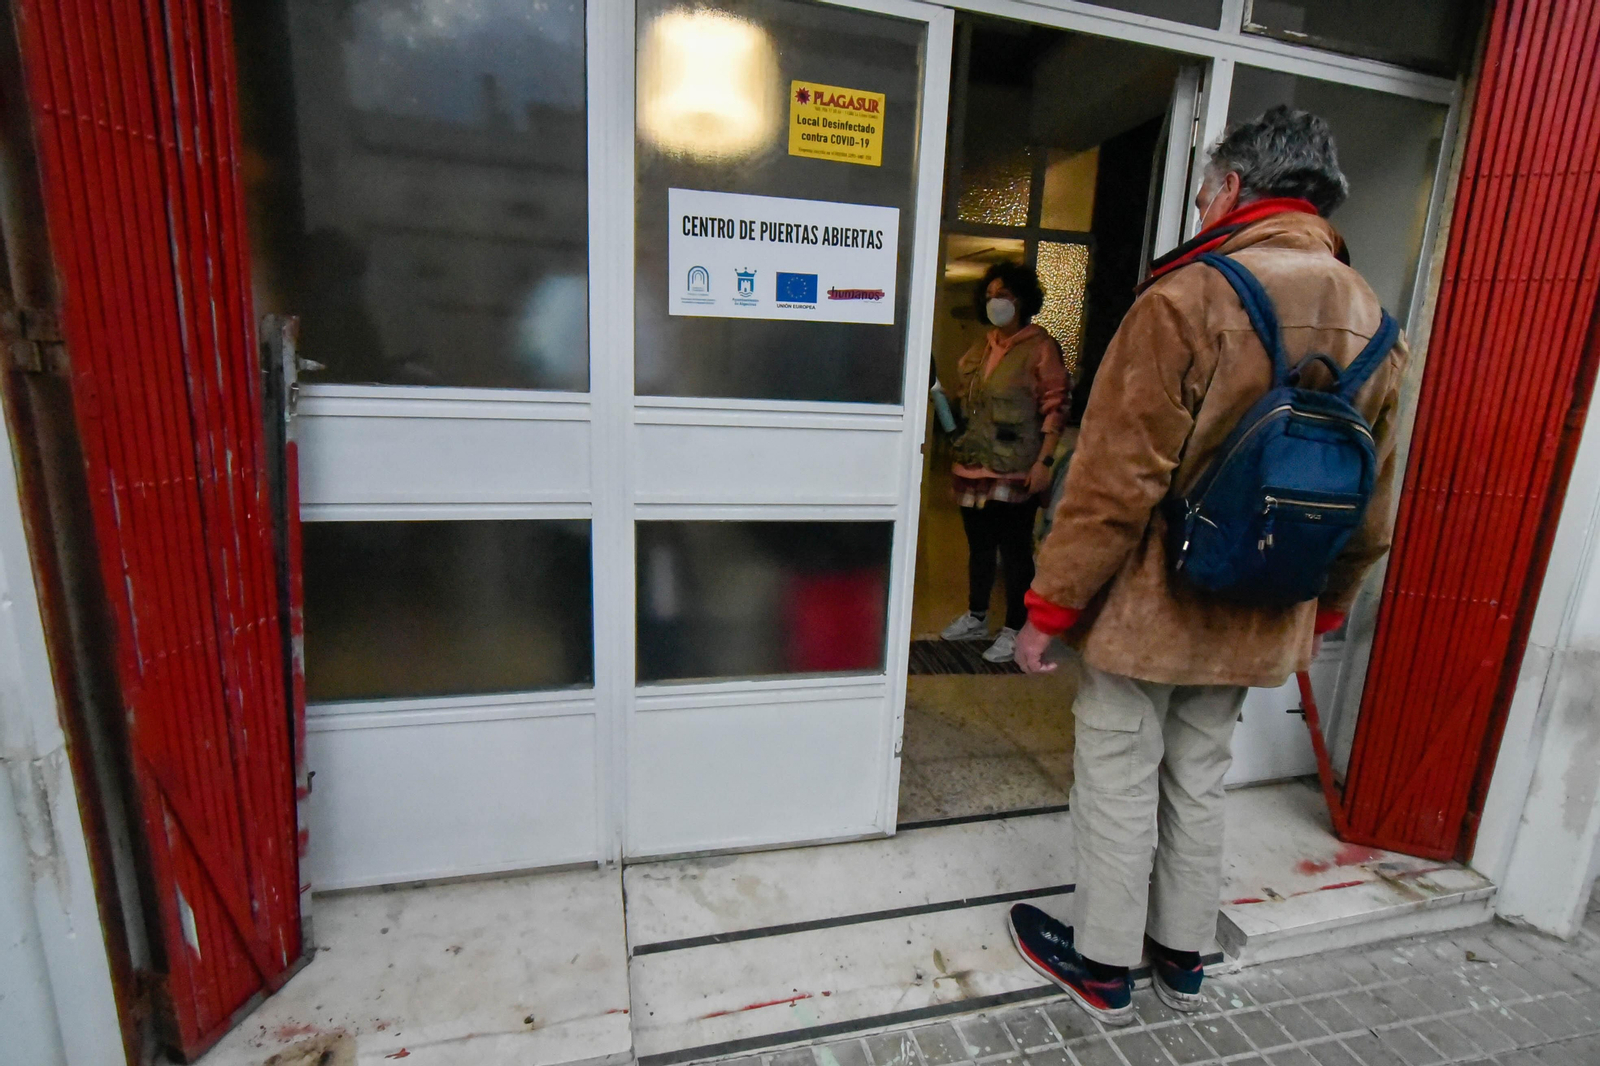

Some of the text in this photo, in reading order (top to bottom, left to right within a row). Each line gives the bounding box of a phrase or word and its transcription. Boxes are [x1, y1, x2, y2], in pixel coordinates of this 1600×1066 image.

[813, 91, 880, 114] PLAGASUR
[797, 114, 876, 134] Local Desinfectado
[801, 132, 870, 149] contra COVID-19
[682, 215, 884, 250] CENTRO DE PUERTAS ABIERTAS
[831, 286, 881, 301] humanos
